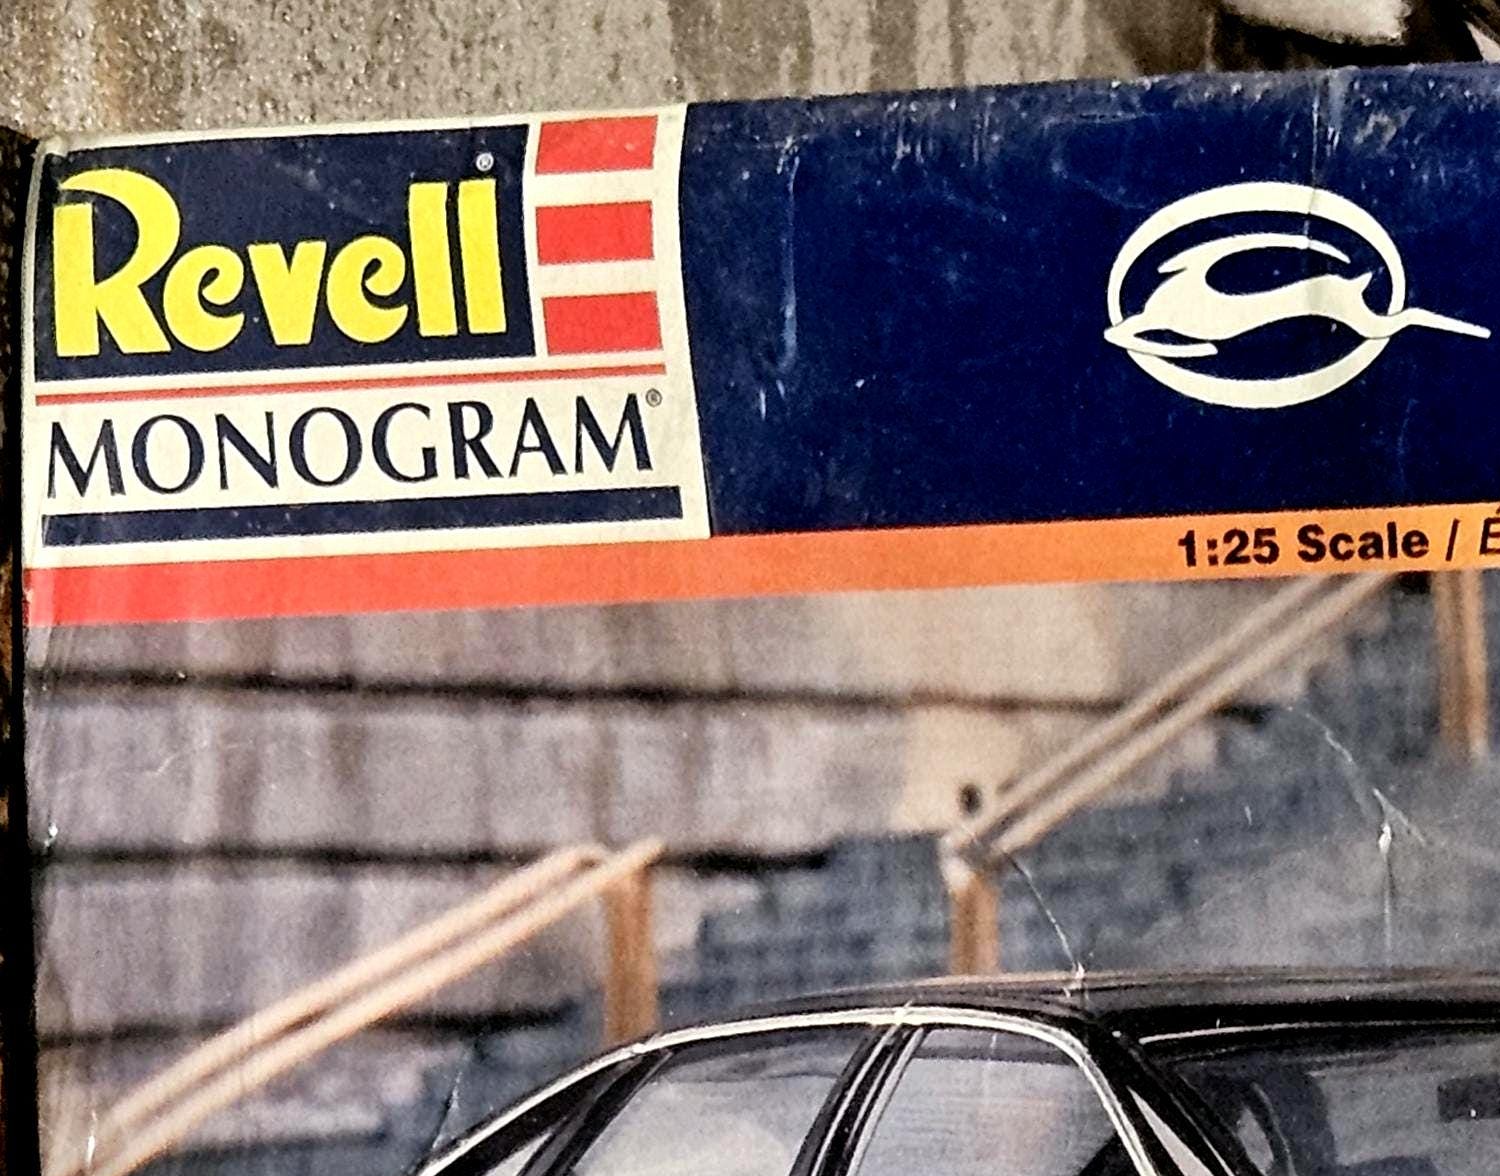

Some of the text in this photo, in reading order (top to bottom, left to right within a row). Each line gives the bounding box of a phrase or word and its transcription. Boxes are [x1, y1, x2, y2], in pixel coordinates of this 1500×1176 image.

[52, 168, 507, 357] Revell
[47, 392, 653, 499] MONOGRAM
[1178, 528, 1281, 567] 1:25
[1297, 523, 1430, 563] Scale
